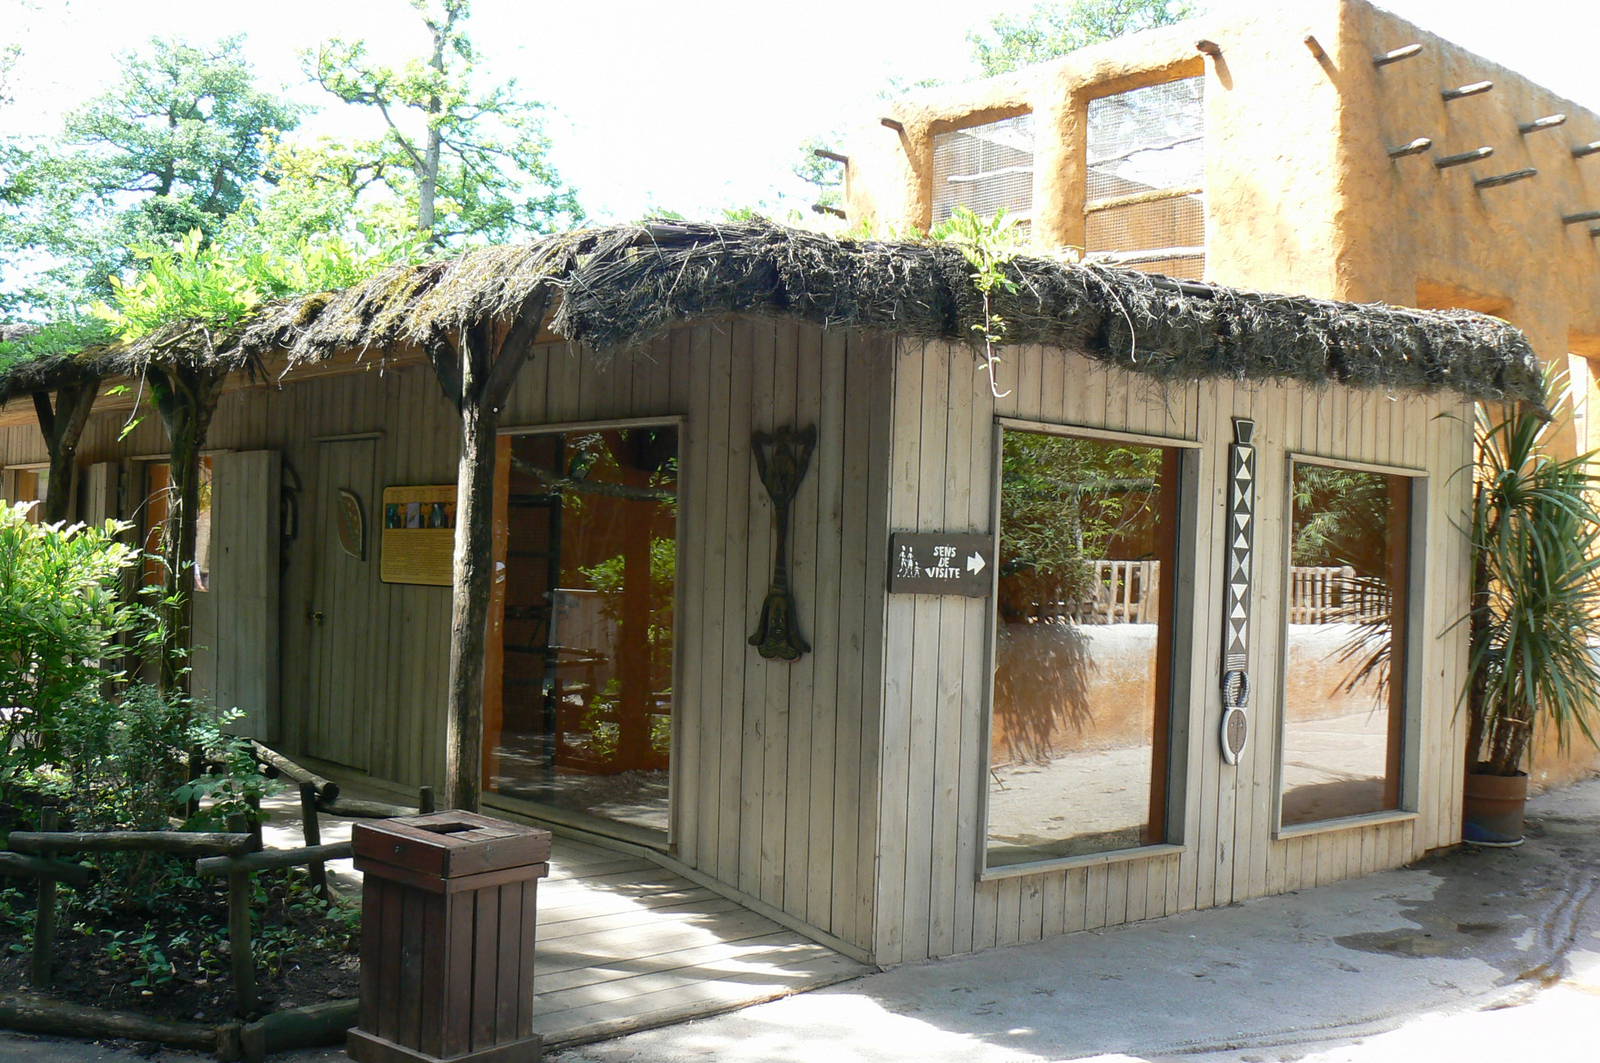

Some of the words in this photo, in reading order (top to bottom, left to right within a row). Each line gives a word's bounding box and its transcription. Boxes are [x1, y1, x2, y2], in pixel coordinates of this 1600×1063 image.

[933, 546, 957, 557] SENS
[938, 557, 950, 567] DE
[925, 567, 960, 579] VISITE
